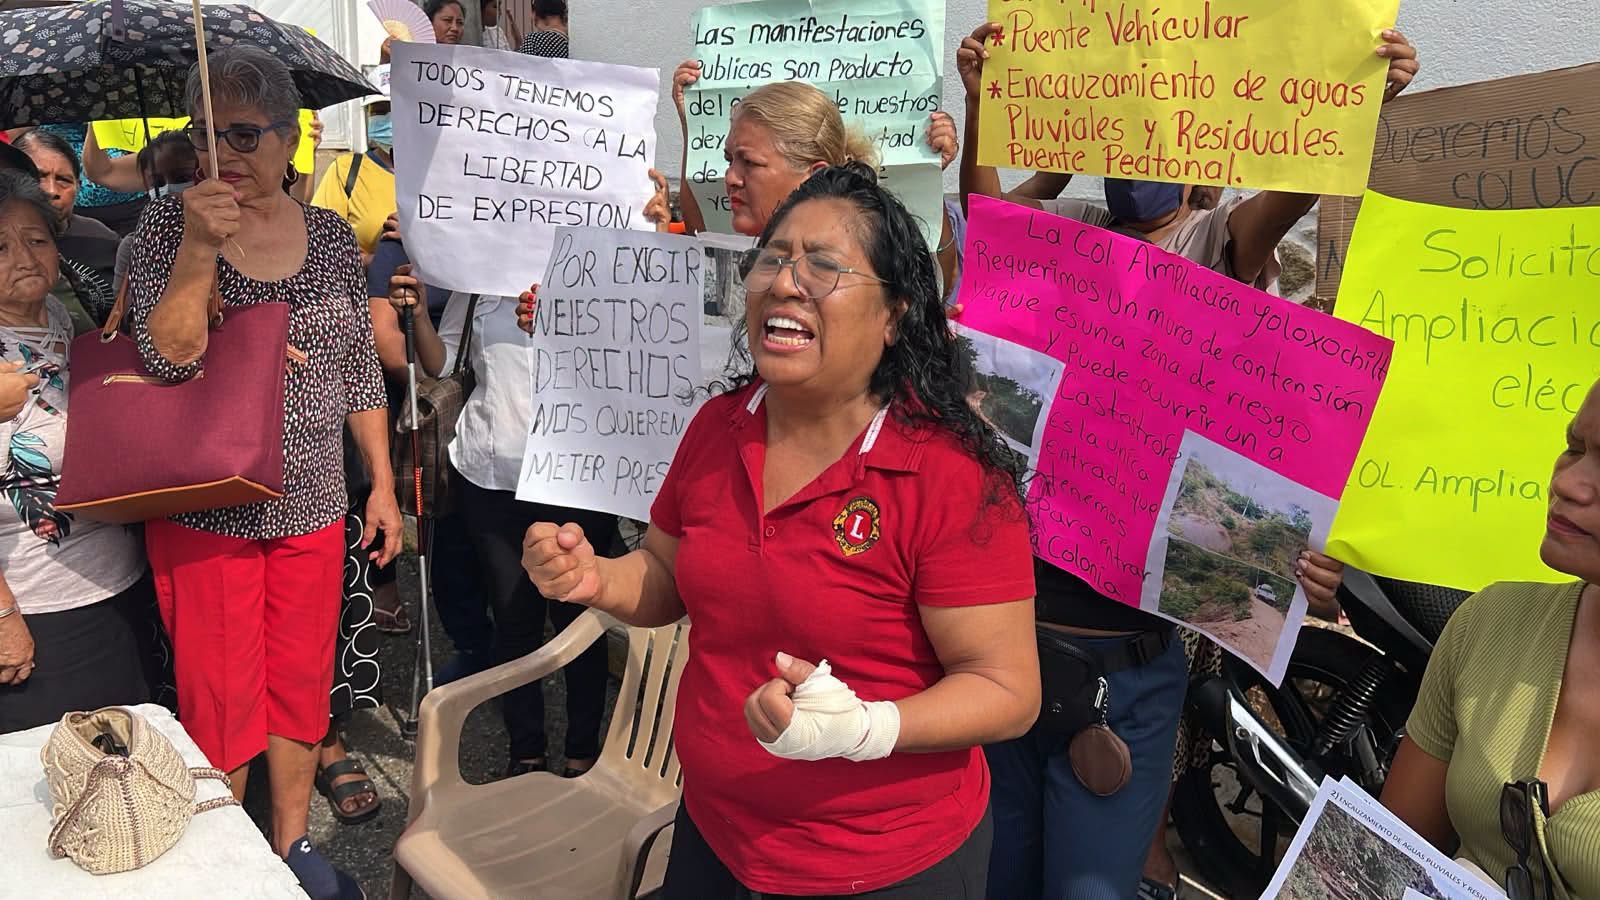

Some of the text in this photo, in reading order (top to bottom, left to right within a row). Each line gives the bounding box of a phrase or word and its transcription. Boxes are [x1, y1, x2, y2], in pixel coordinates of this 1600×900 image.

[695, 14, 926, 46] Las manifestaciones
[1007, 9, 1091, 53] Puente
[410, 60, 614, 118] TODOS TENEMOS
[689, 89, 723, 117] del
[854, 89, 939, 116] nuestros
[1007, 60, 1366, 118] Encauzamiento de aguas
[417, 101, 571, 143] DERECHOS
[617, 133, 647, 163] LA
[1007, 104, 1125, 143] Pluviales
[1170, 109, 1345, 157] Residuales.
[463, 152, 603, 191] LIBERTAD
[692, 160, 718, 184] de
[1007, 142, 1243, 185] Puente Peatonal.
[418, 194, 453, 220] DE
[1027, 213, 1064, 246] La
[547, 233, 597, 289] POR
[972, 239, 1101, 303] Requerimos
[1147, 307, 1194, 346] muro
[1200, 330, 1224, 361] de
[534, 346, 695, 400] DERECHOS
[530, 402, 686, 437] NOS QUIEREN
[1189, 362, 1216, 394] de
[1226, 391, 1312, 444] riesgo
[525, 450, 605, 483] METER
[1347, 459, 1543, 513] OL. Amplia
[849, 514, 864, 540] L
[1339, 797, 1393, 837] ENCAUZAMIENTO
[1400, 841, 1426, 861] AGUAS
[1424, 856, 1462, 886] PLUVIALES
